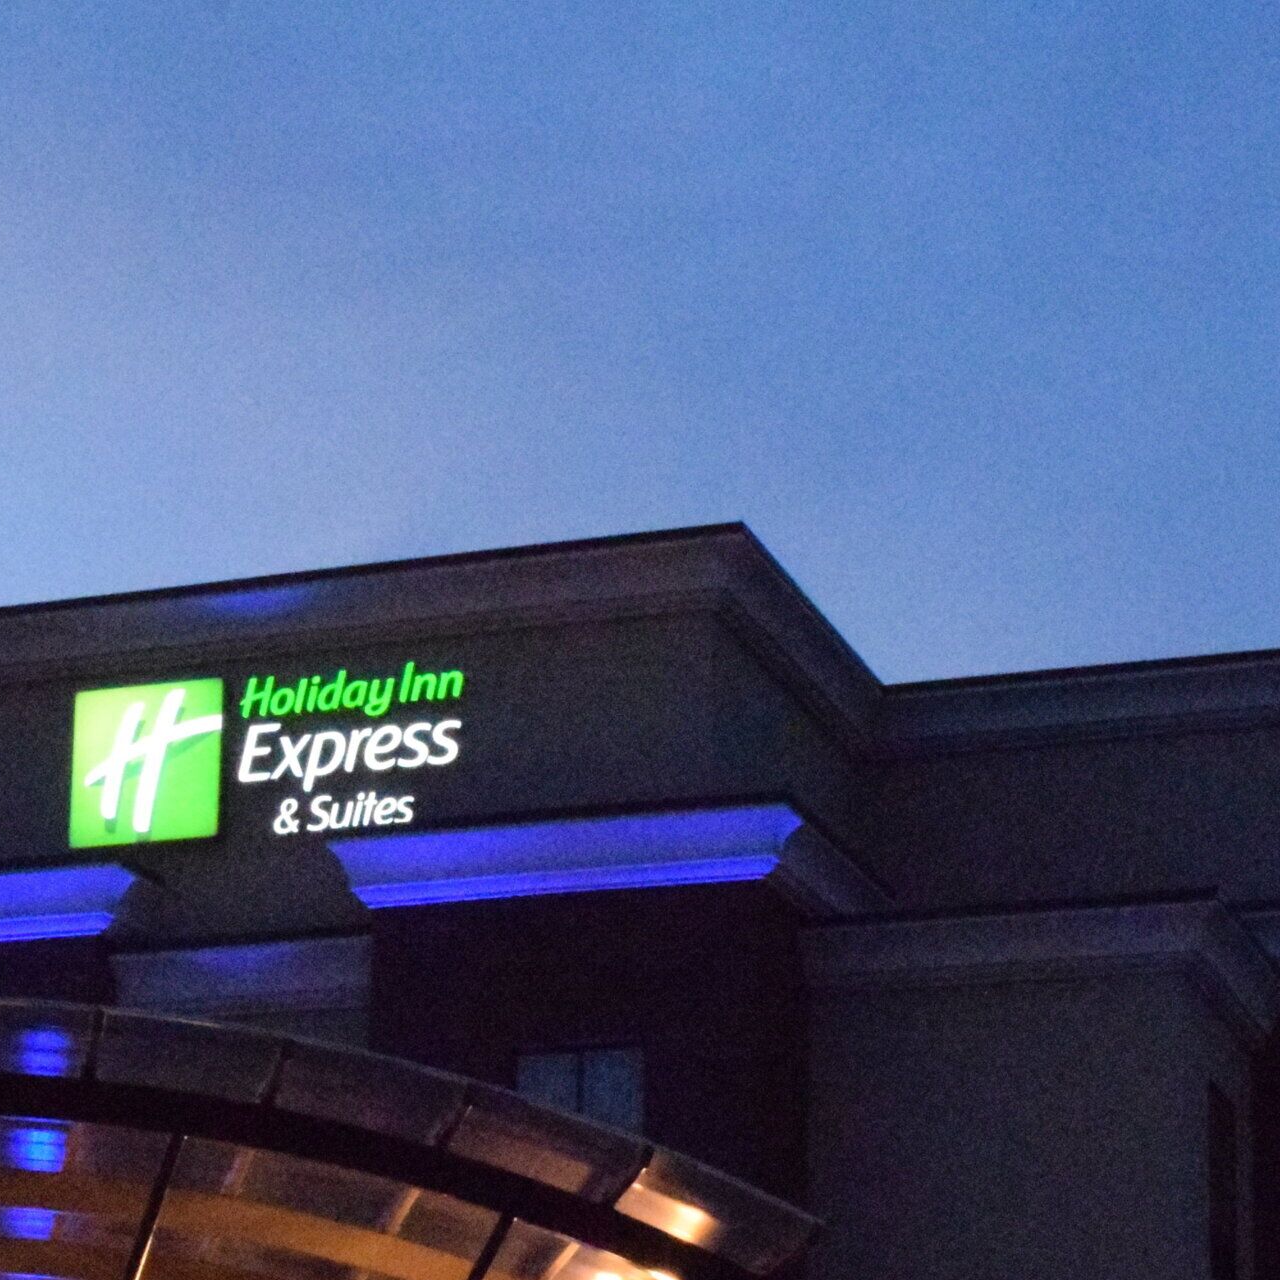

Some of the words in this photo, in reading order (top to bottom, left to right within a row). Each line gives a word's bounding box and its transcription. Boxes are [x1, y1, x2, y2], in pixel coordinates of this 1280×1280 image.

[240, 669, 395, 718] Holiday
[399, 661, 464, 703] Inn
[238, 719, 462, 792] Express
[273, 798, 300, 835] &
[306, 791, 415, 832] Suites
